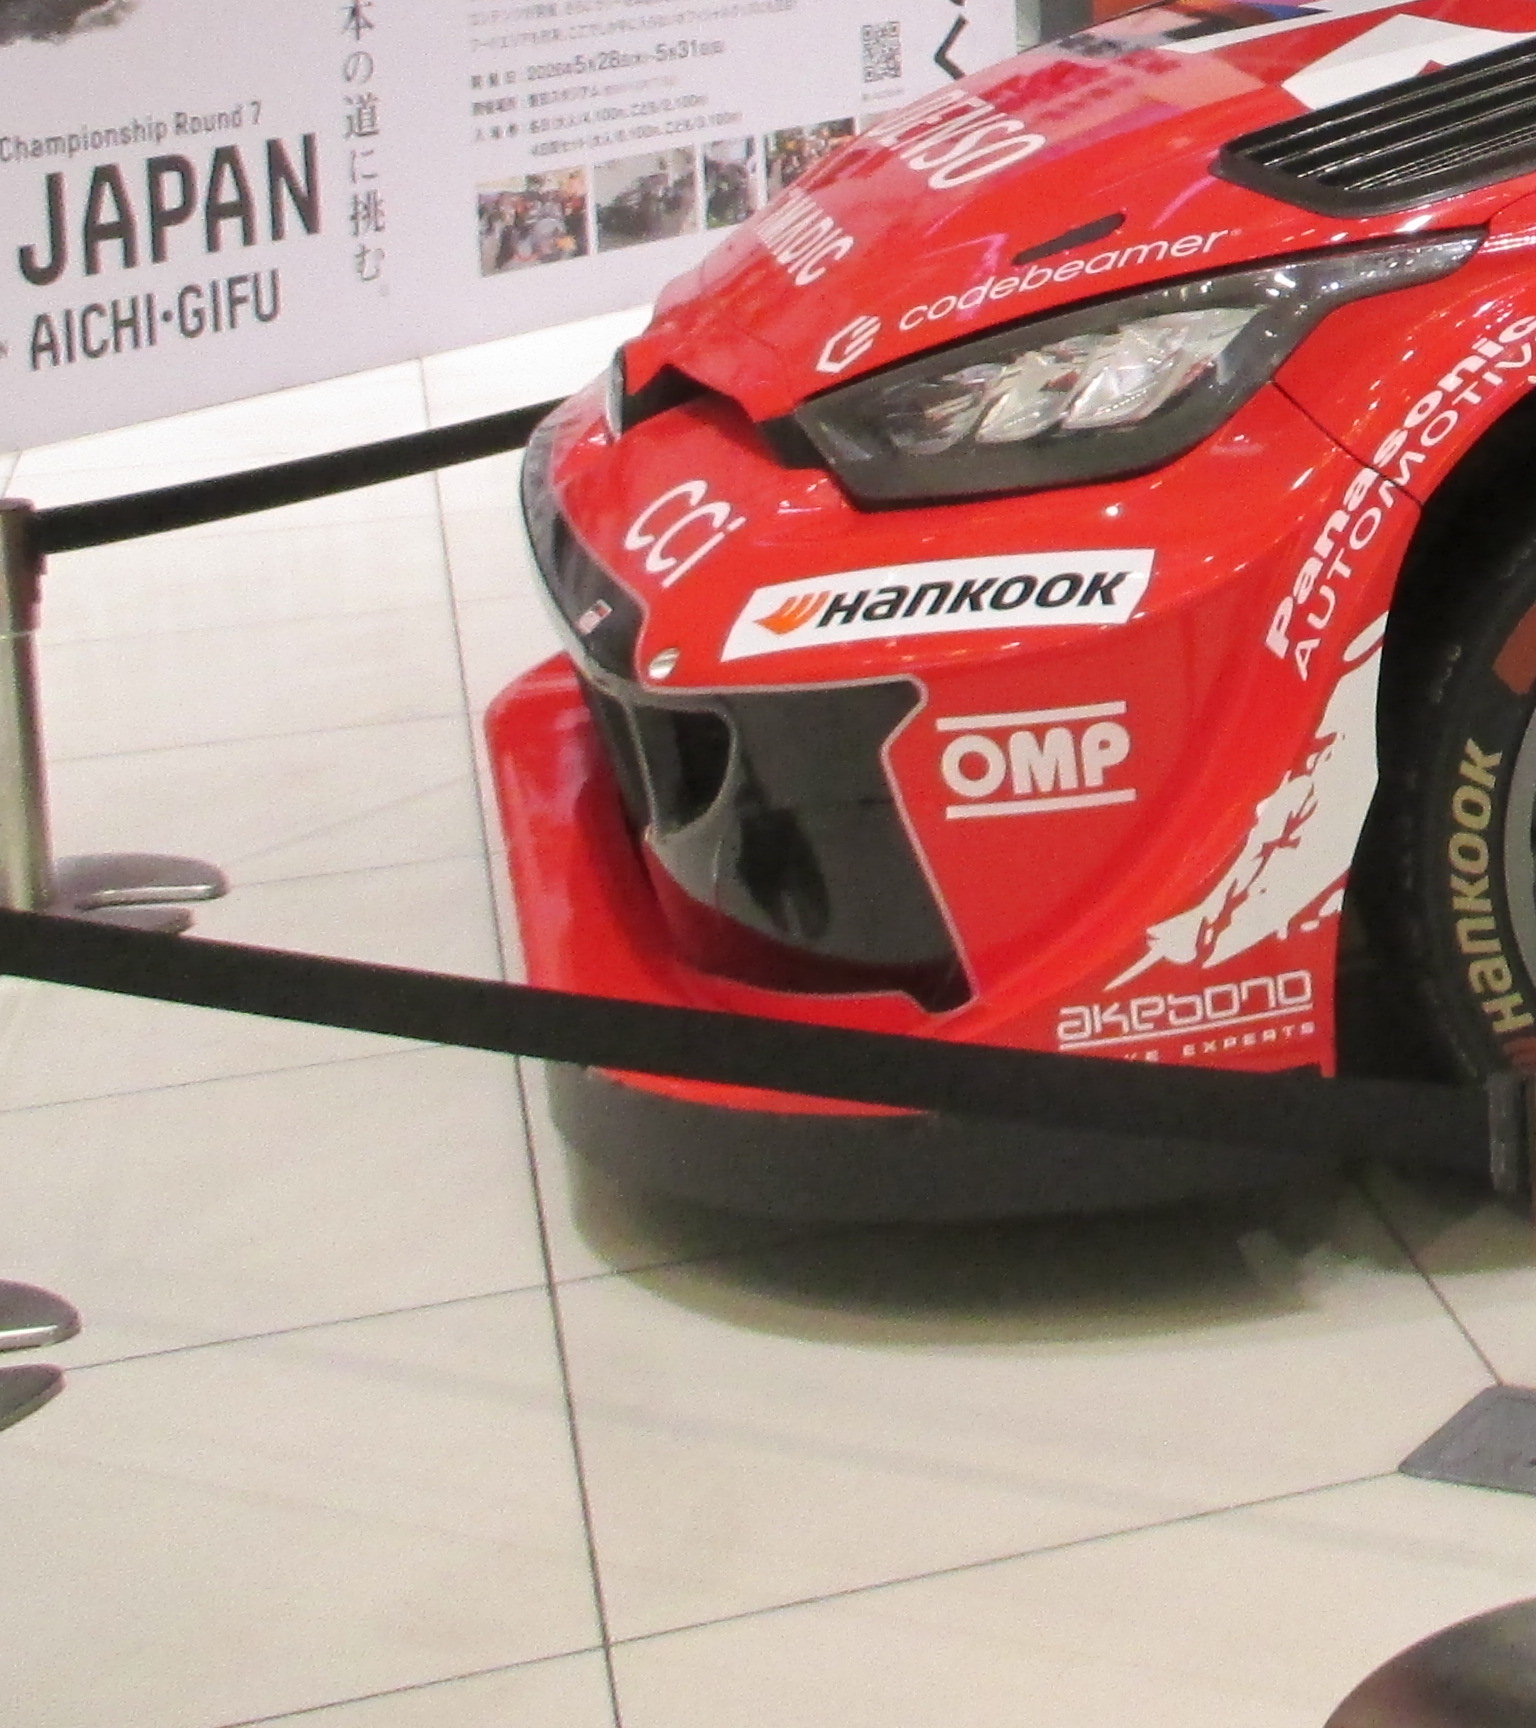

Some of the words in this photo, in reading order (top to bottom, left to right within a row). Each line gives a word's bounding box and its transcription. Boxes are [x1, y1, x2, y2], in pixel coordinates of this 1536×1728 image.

[174, 108, 243, 138] Round
[18, 132, 322, 287] JAPAN
[898, 227, 1232, 333] codebeamer
[940, 720, 1131, 799] OMP
